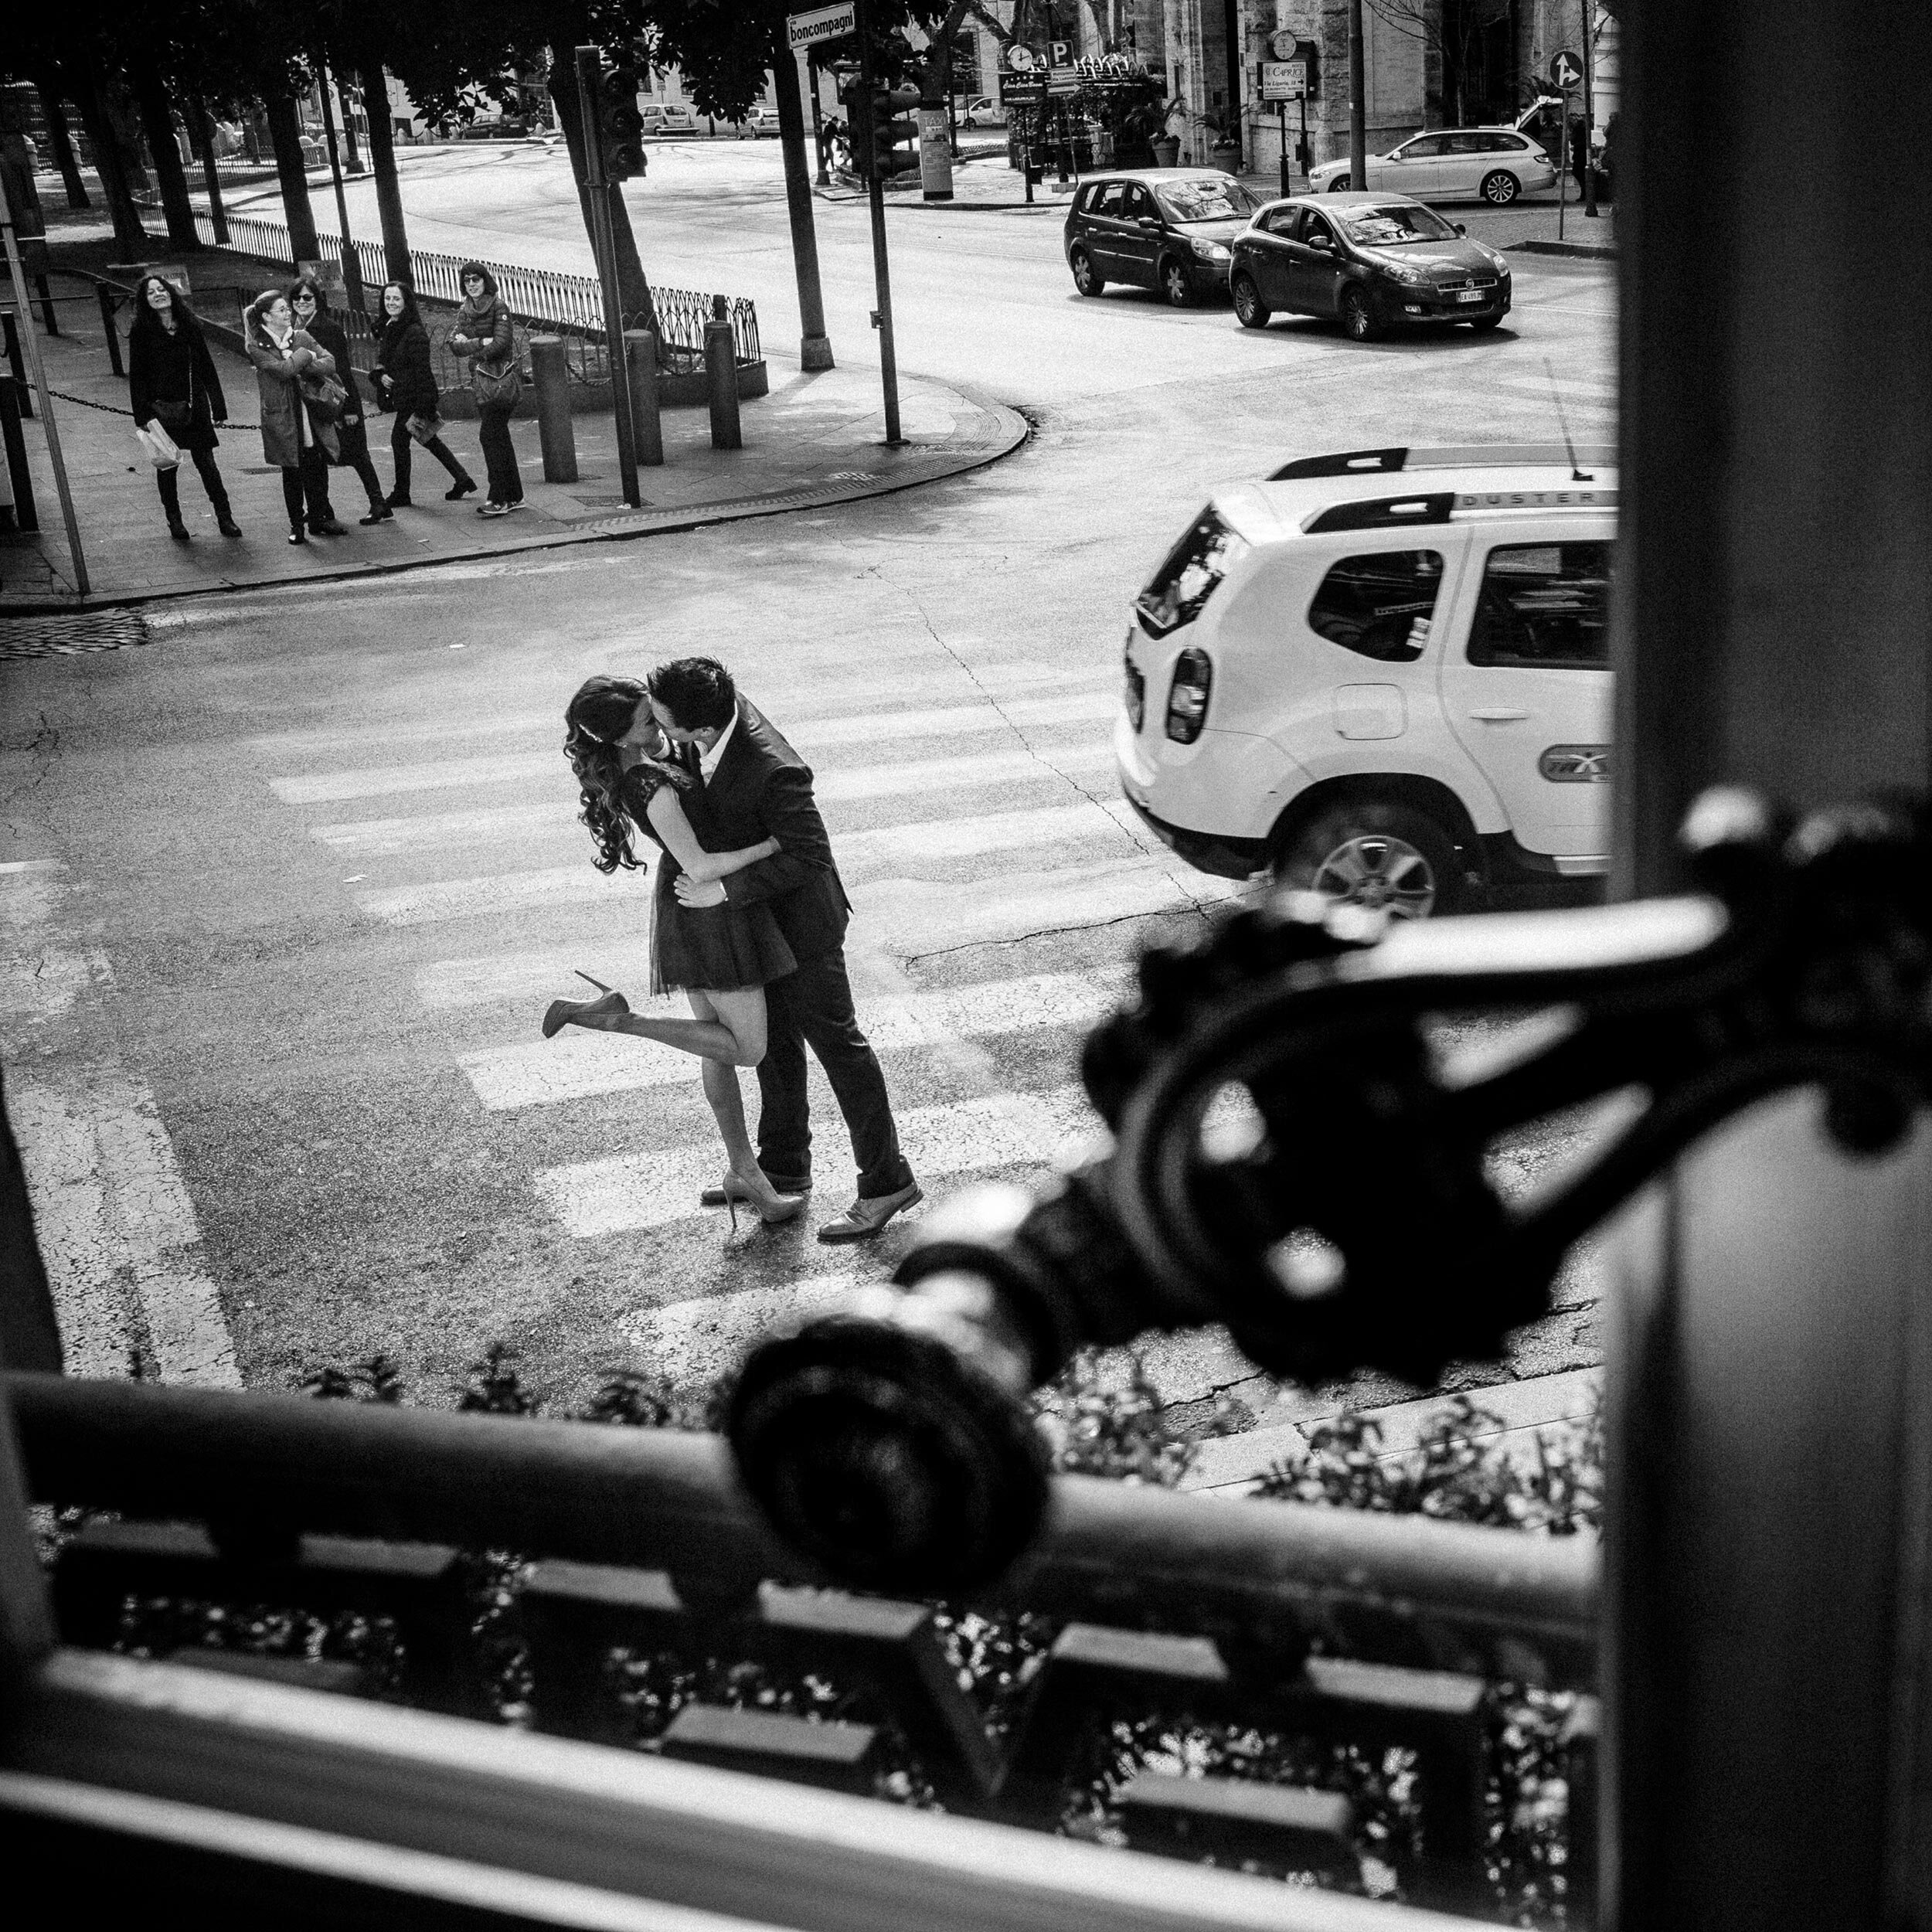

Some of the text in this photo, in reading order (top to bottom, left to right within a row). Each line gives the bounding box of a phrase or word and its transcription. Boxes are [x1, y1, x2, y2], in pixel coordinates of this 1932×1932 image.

[790, 11, 853, 42] boncompagni
[1053, 43, 1067, 63] P
[923, 117, 946, 126] TAXI
[1462, 492, 1594, 506] DUSTER
